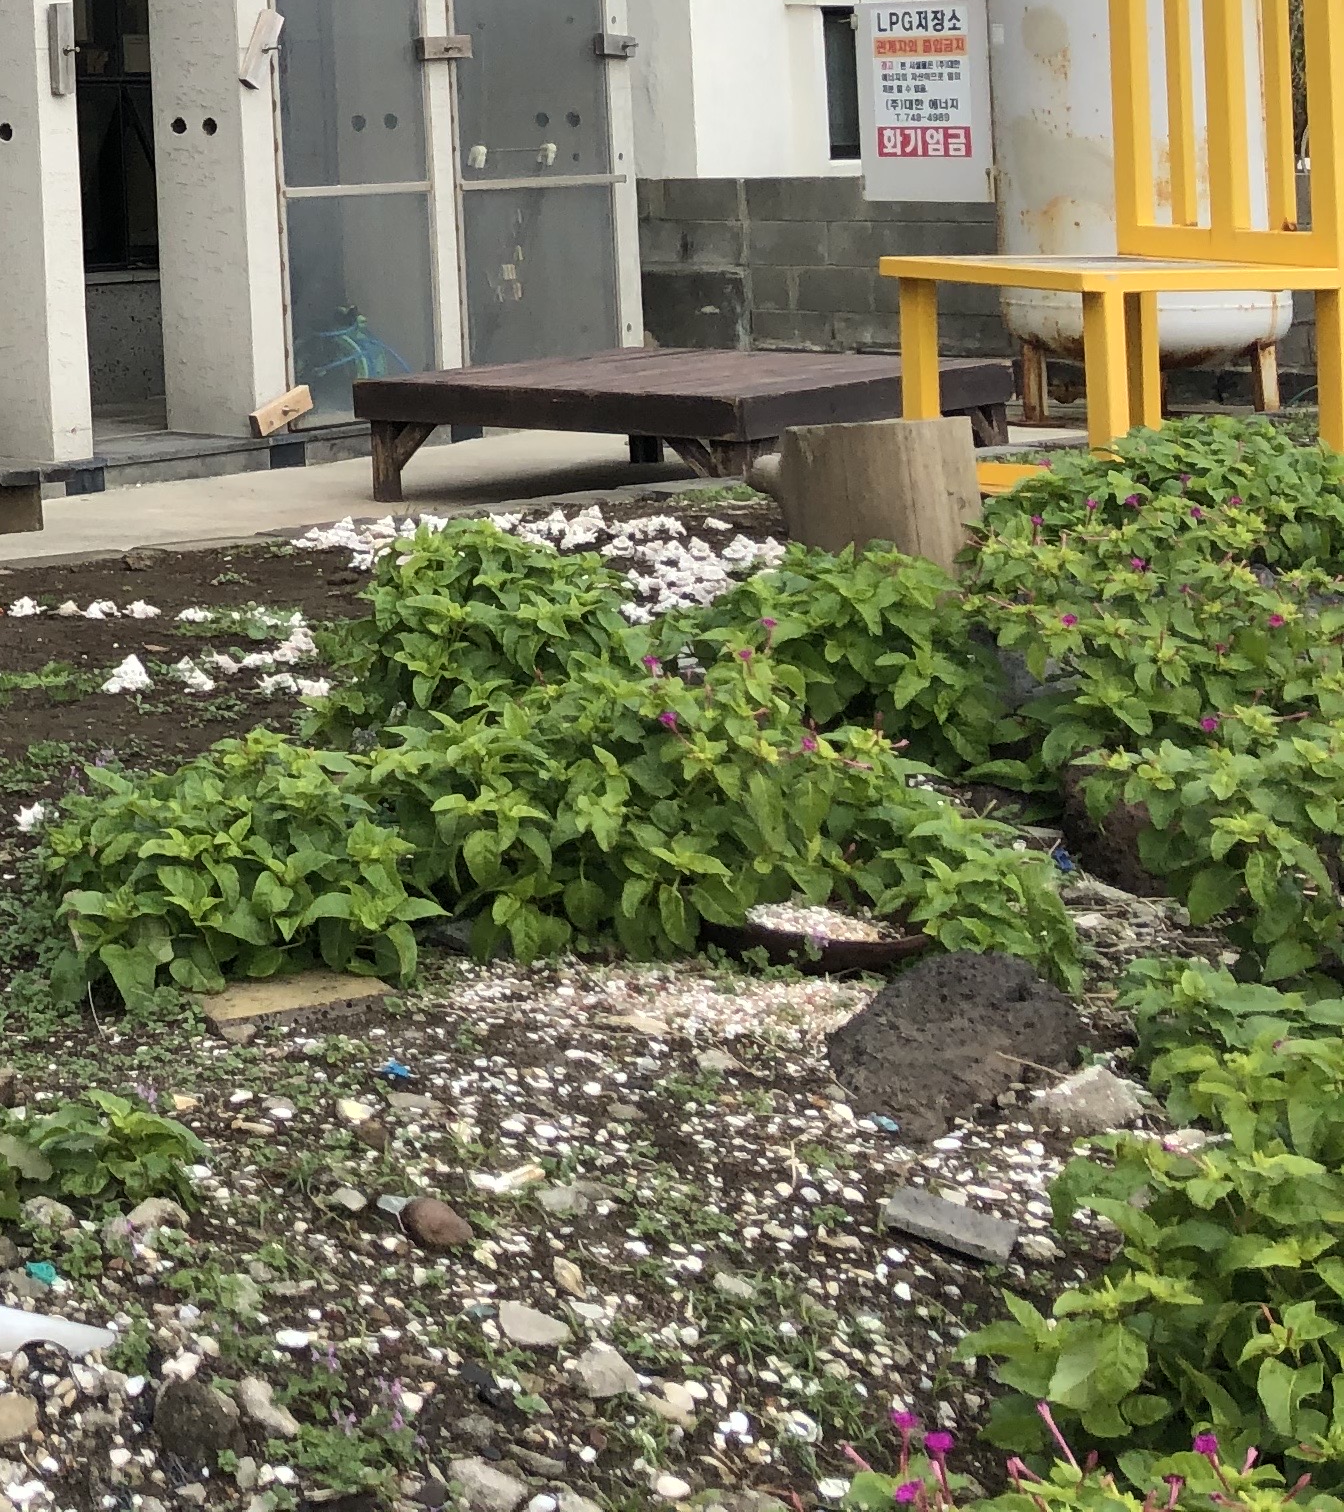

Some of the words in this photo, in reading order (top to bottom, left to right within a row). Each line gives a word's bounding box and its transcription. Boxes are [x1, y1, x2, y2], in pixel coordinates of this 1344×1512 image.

[876, 8, 962, 32] LPG저장소
[885, 98, 924, 110] (주)대한
[928, 98, 959, 110] 에너지
[882, 128, 967, 156] 화기엄금
